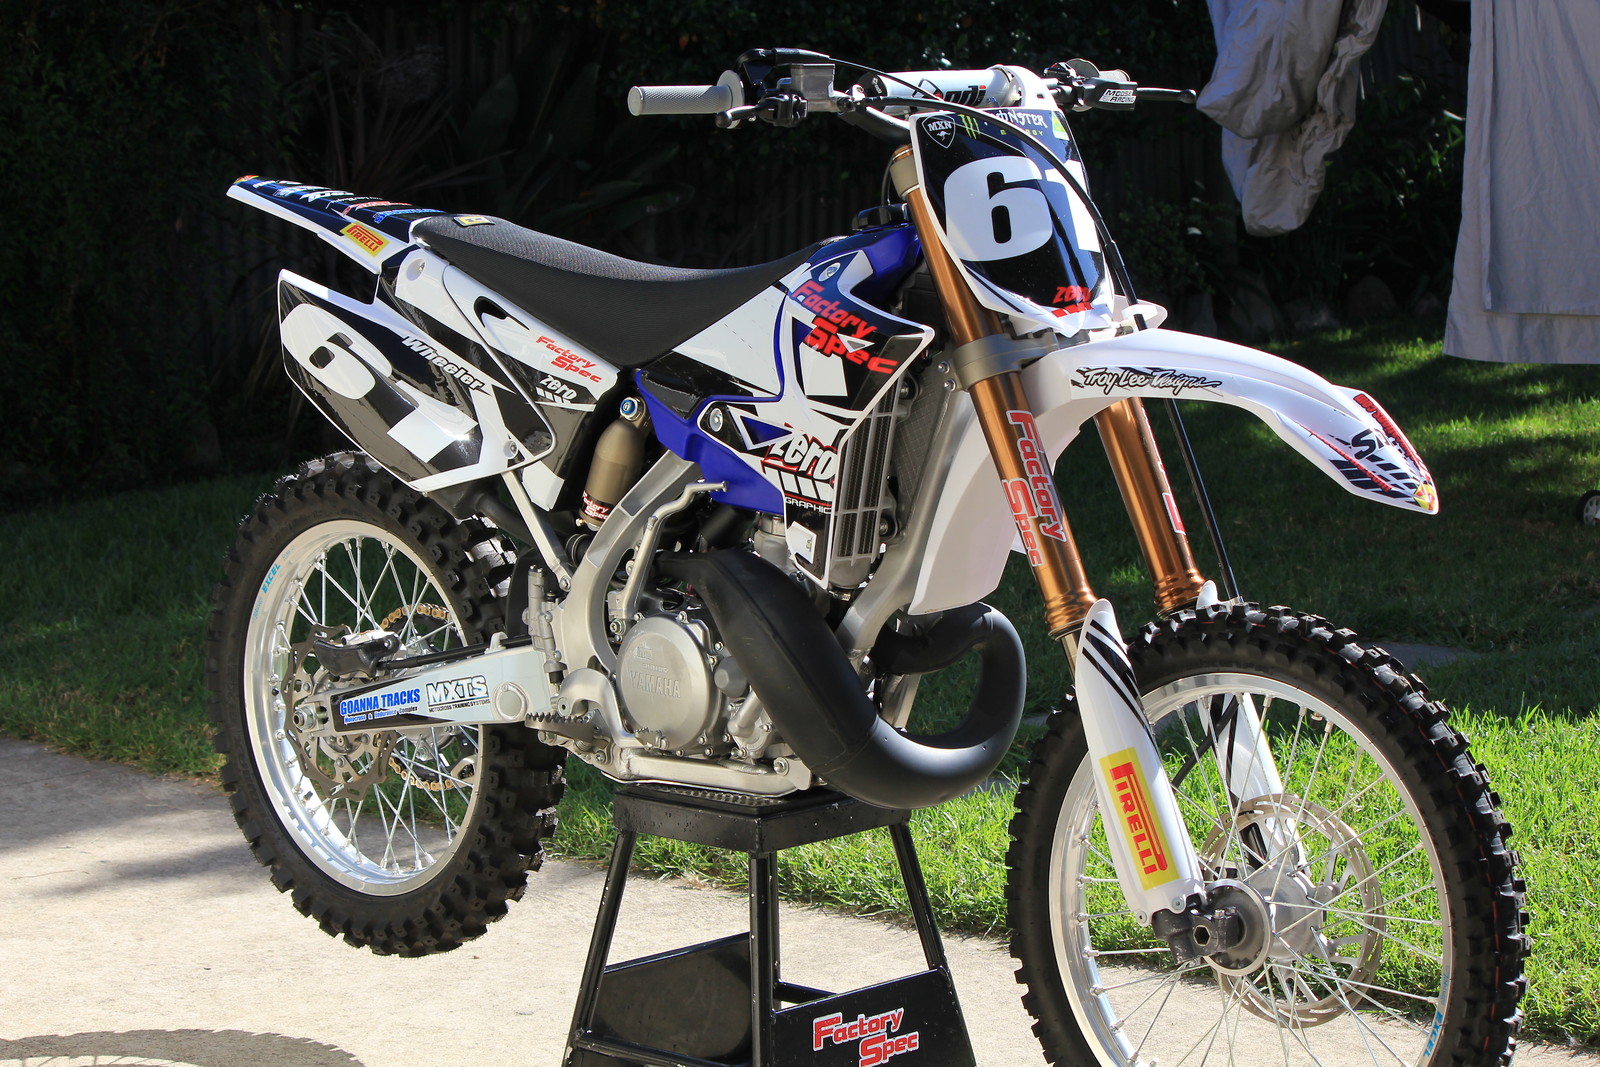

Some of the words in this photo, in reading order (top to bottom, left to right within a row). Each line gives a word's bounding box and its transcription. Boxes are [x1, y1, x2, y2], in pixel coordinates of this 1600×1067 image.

[928, 120, 952, 132] MXN
[347, 223, 384, 252] PIRELLI
[791, 279, 878, 340] Factory
[536, 336, 597, 368] Factory
[803, 317, 899, 375] Spec
[401, 336, 487, 391] Wheeler
[550, 356, 602, 383] Spec
[540, 374, 578, 400] zero
[1083, 367, 1119, 395] Troy
[1118, 369, 1151, 387] Lee
[1150, 368, 1222, 396] Designs
[1006, 410, 1067, 542] Factory
[1002, 477, 1045, 567] Spec
[261, 563, 281, 594] EXCEL
[425, 674, 490, 706] MXTS
[630, 671, 681, 698] YAMAHA
[339, 694, 380, 716] GOANNA
[380, 688, 421, 710] TRACKS
[399, 706, 418, 715] Complex
[428, 704, 452, 713] MOTOCROSS
[452, 701, 471, 709] TRAINING
[1109, 762, 1168, 875] PIRELLI
[813, 1007, 905, 1051] Factory
[1423, 1010, 1444, 1057] EXCEL
[859, 1031, 919, 1067] Spec
